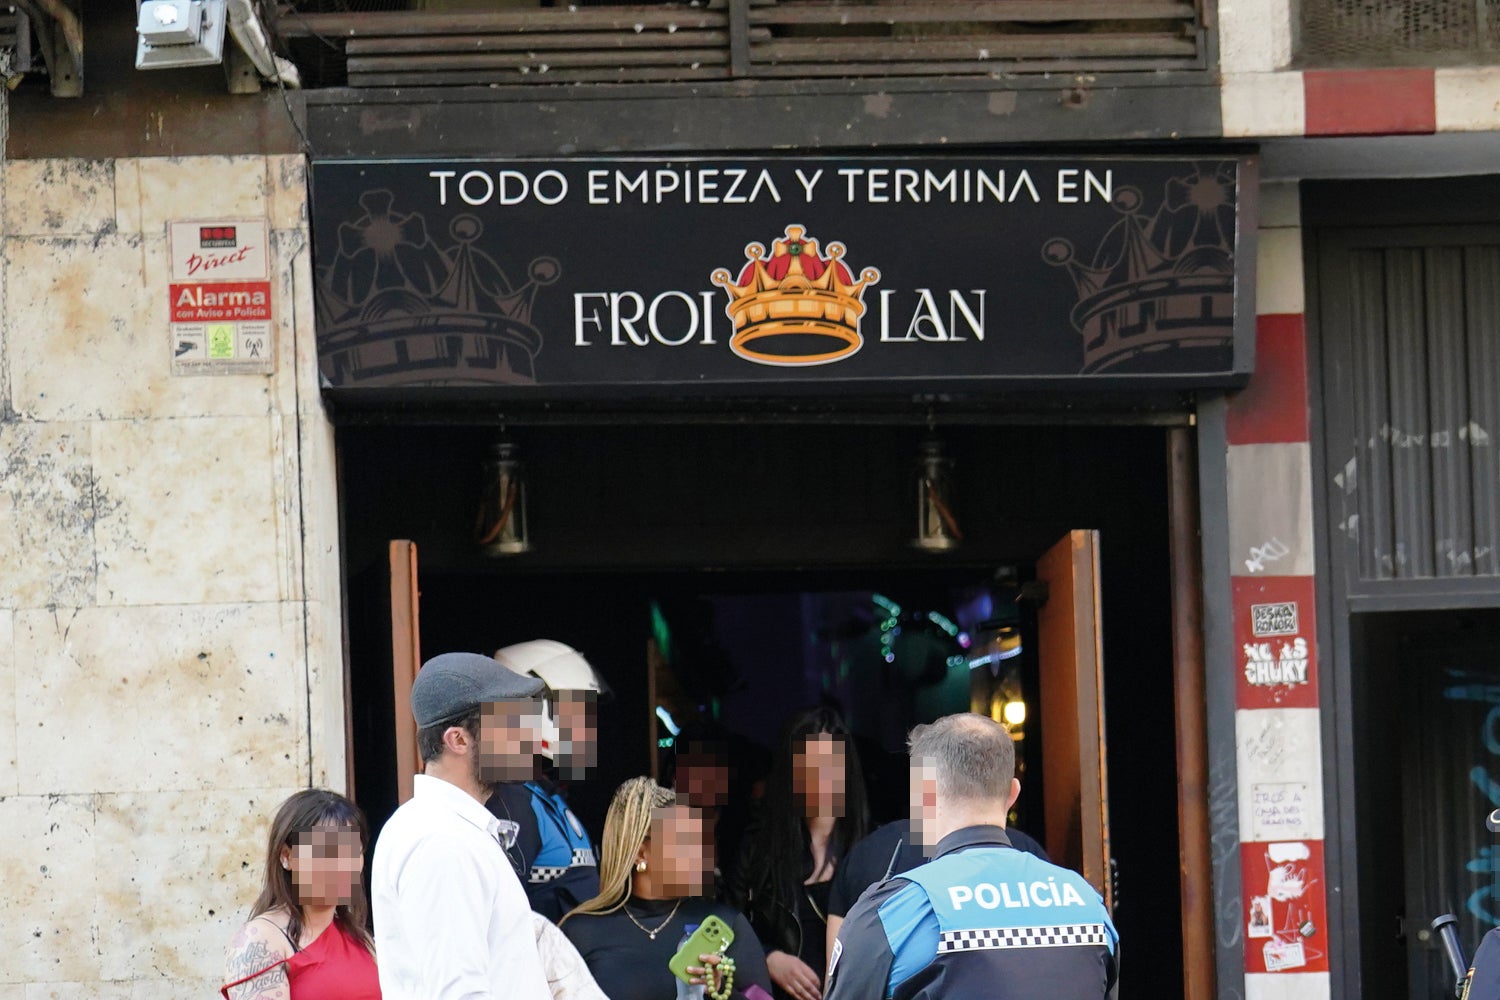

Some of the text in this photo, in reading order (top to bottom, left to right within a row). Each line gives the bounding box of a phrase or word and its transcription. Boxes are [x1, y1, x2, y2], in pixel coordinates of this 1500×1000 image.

[429, 168, 1113, 206] TODO EMPIEZA Y TERMINA EN
[185, 245, 255, 276] Direct
[176, 286, 266, 307] Alarma
[176, 309, 194, 318] con
[196, 308, 223, 318] Aviso
[225, 309, 232, 317] a
[573, 288, 988, 347] FROI LAN
[946, 875, 1086, 912] POLICÍA
